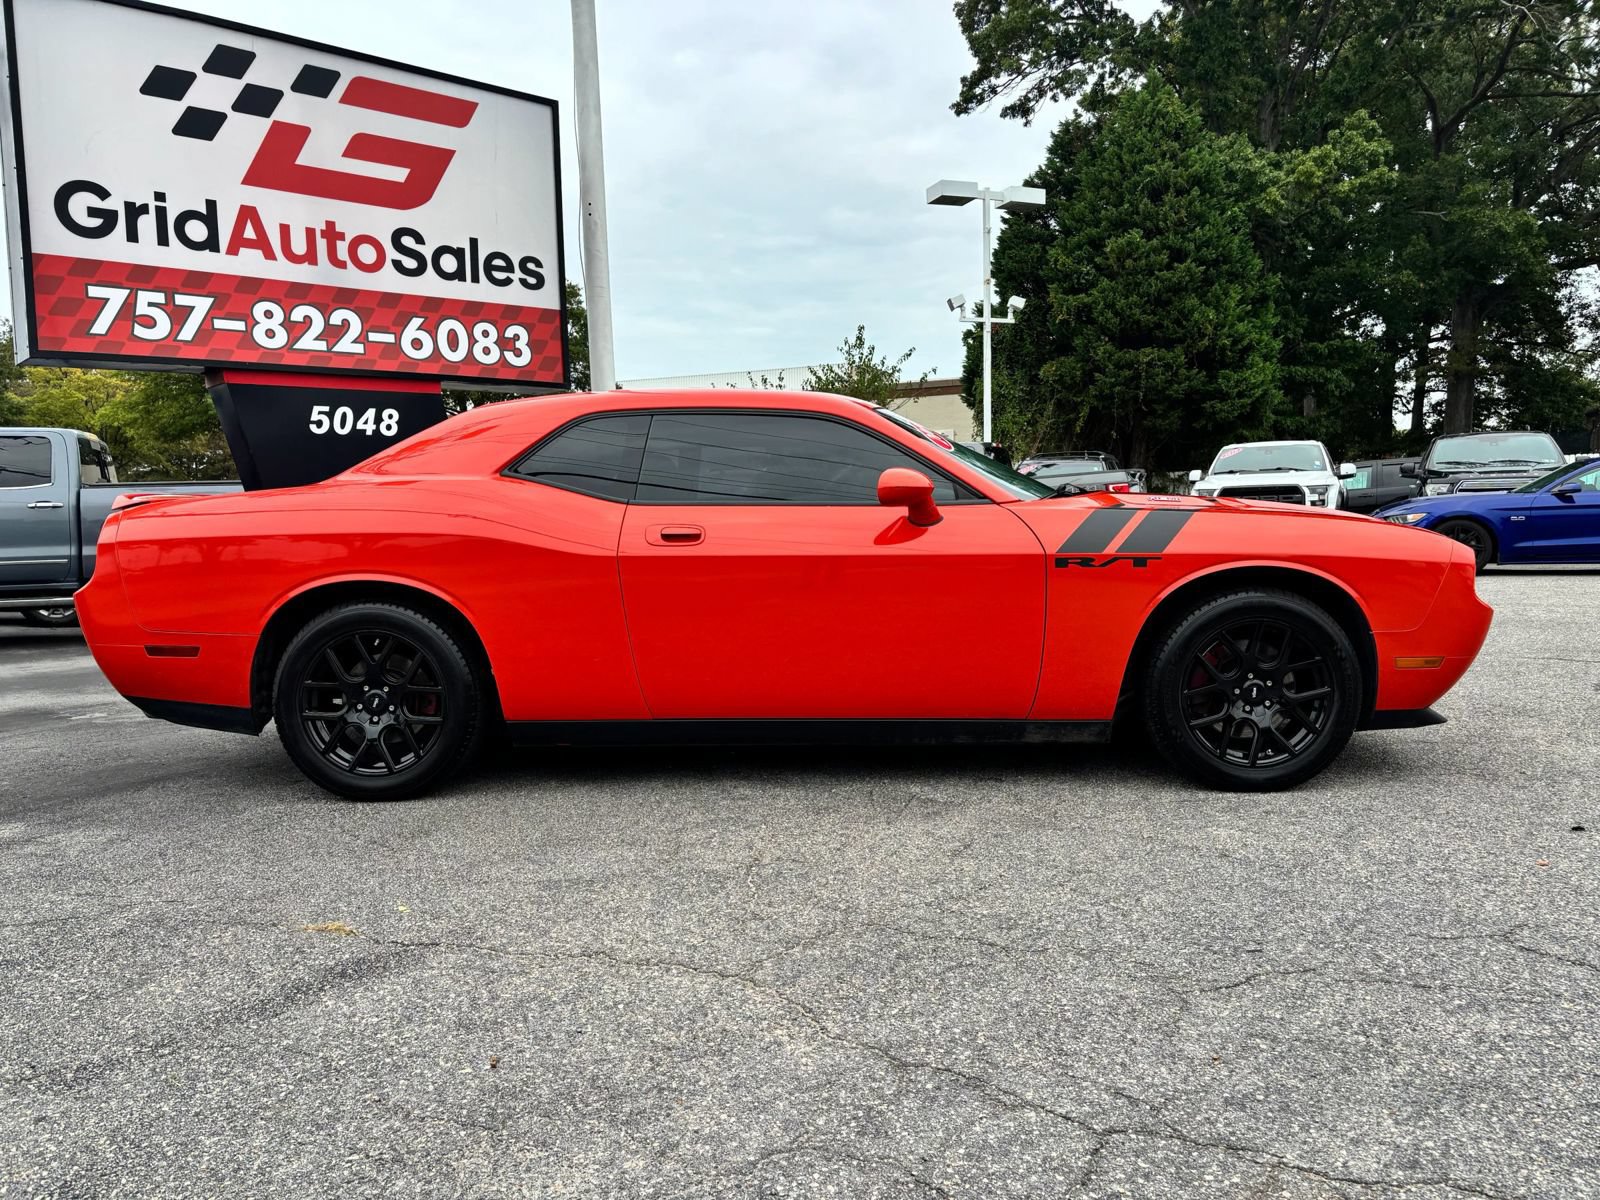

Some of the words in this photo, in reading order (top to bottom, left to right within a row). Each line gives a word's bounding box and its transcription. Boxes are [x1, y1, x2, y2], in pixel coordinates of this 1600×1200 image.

[86, 285, 533, 369] 757-822-6083
[308, 405, 400, 437] 5048
[1054, 556, 1163, 569] R/T
